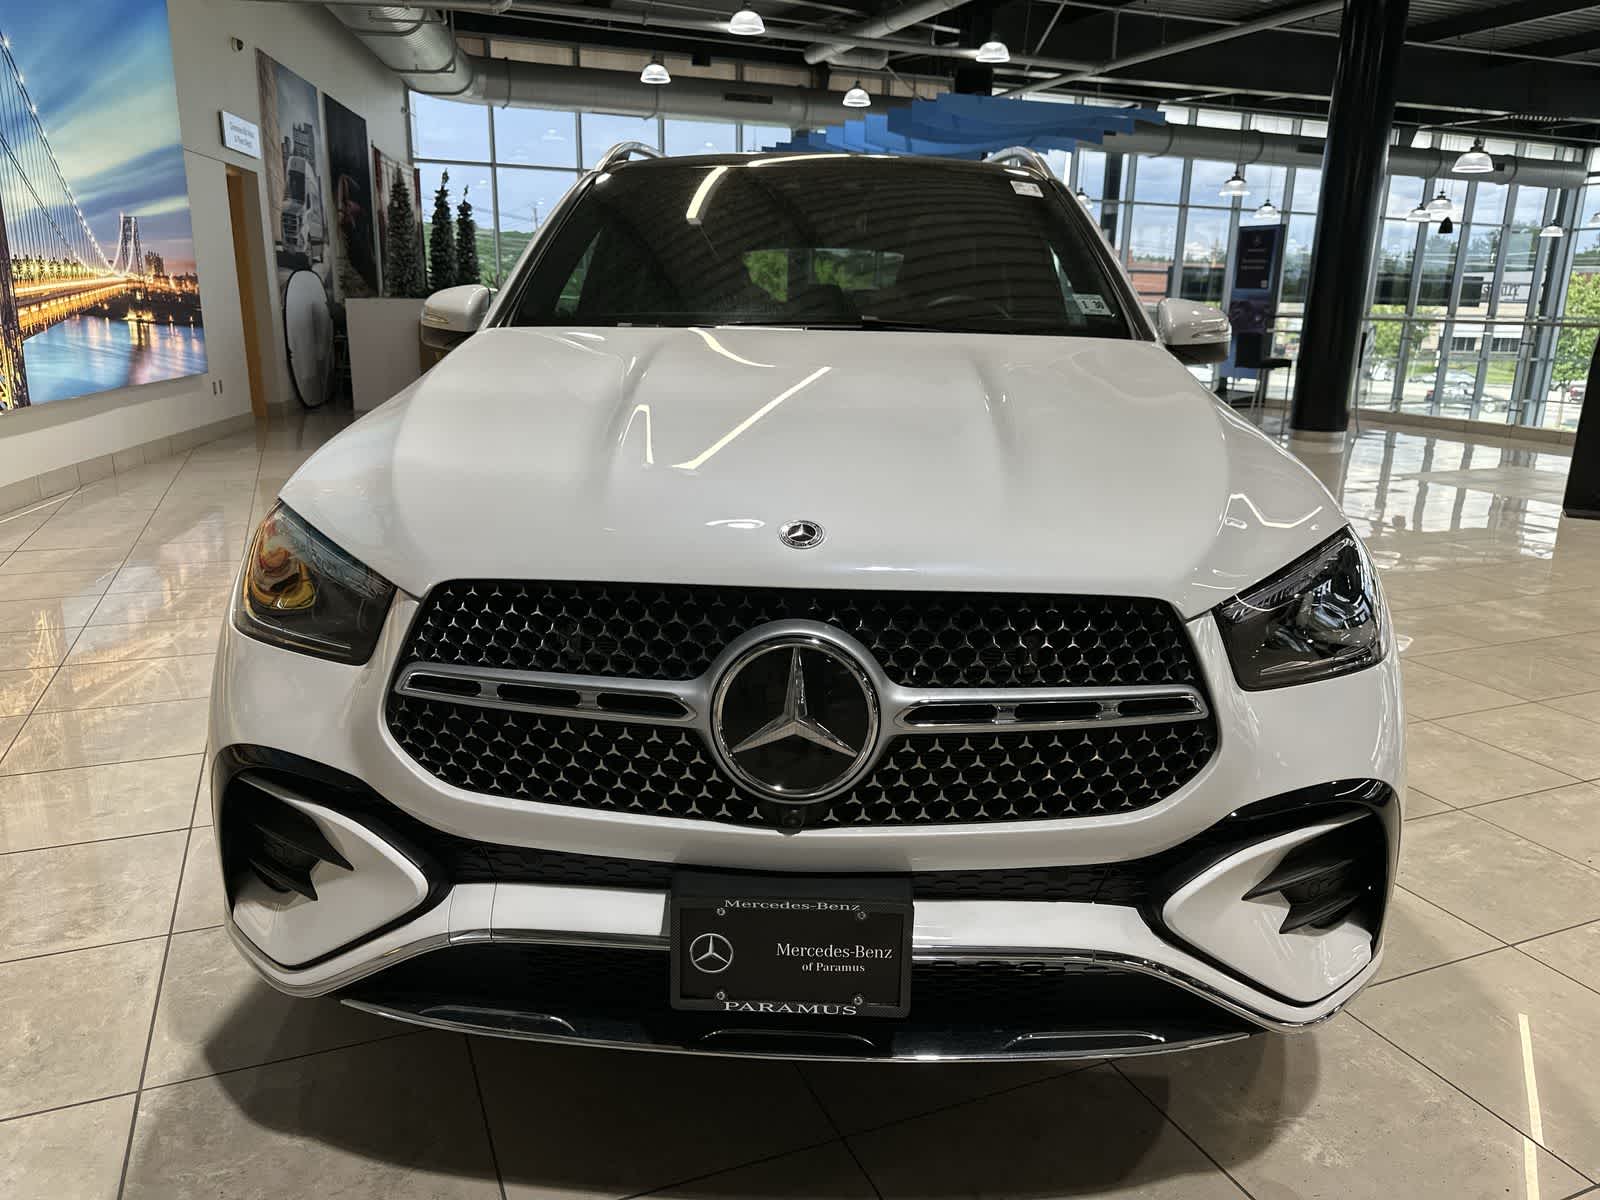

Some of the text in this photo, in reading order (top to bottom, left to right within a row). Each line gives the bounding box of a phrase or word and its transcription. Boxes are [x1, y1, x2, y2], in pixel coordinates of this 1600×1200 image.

[724, 900, 861, 911] Mercedes-Benz
[776, 943, 893, 959] Mercedes-Benz
[801, 962, 865, 972] of Paramus
[724, 1001, 857, 1015] PARAMUS
